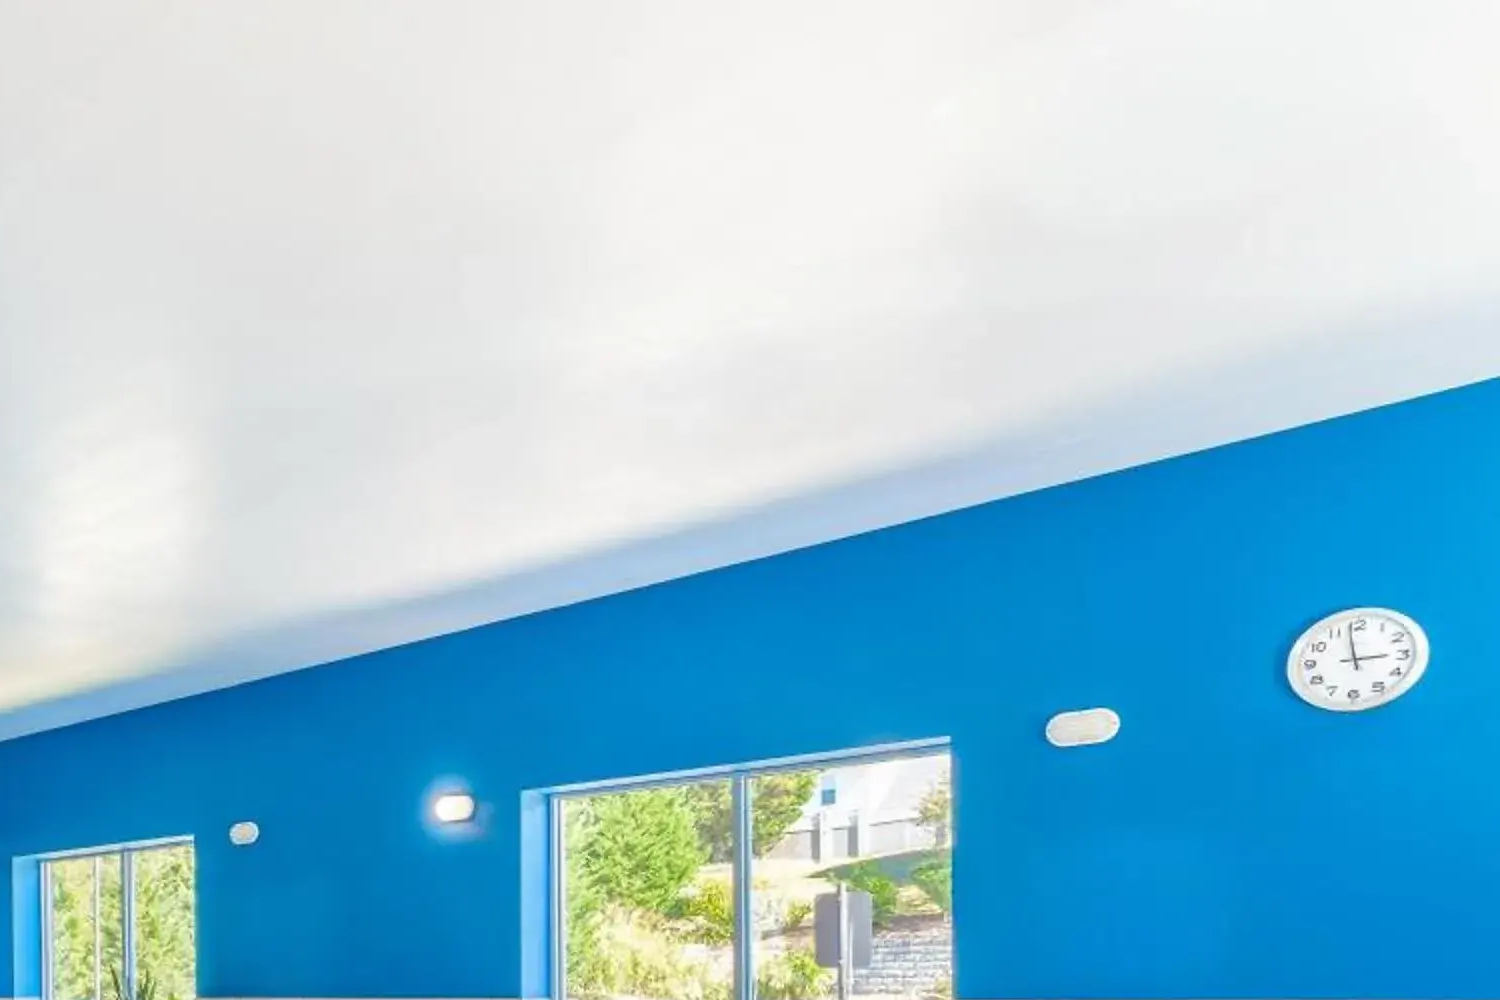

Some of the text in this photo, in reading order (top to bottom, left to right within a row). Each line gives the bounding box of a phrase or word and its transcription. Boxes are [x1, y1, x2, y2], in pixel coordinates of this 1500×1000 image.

[1380, 622, 1385, 632] 1
[1329, 629, 1341, 639] 11
[1391, 631, 1405, 643] 2
[1311, 641, 1327, 652] 10
[1396, 649, 1410, 660] 3
[1304, 659, 1316, 669] 9
[1389, 667, 1402, 677] 4
[1310, 675, 1324, 685] 8
[1326, 685, 1338, 697] 7
[1371, 681, 1385, 693] 5
[1347, 689, 1360, 699] 6
